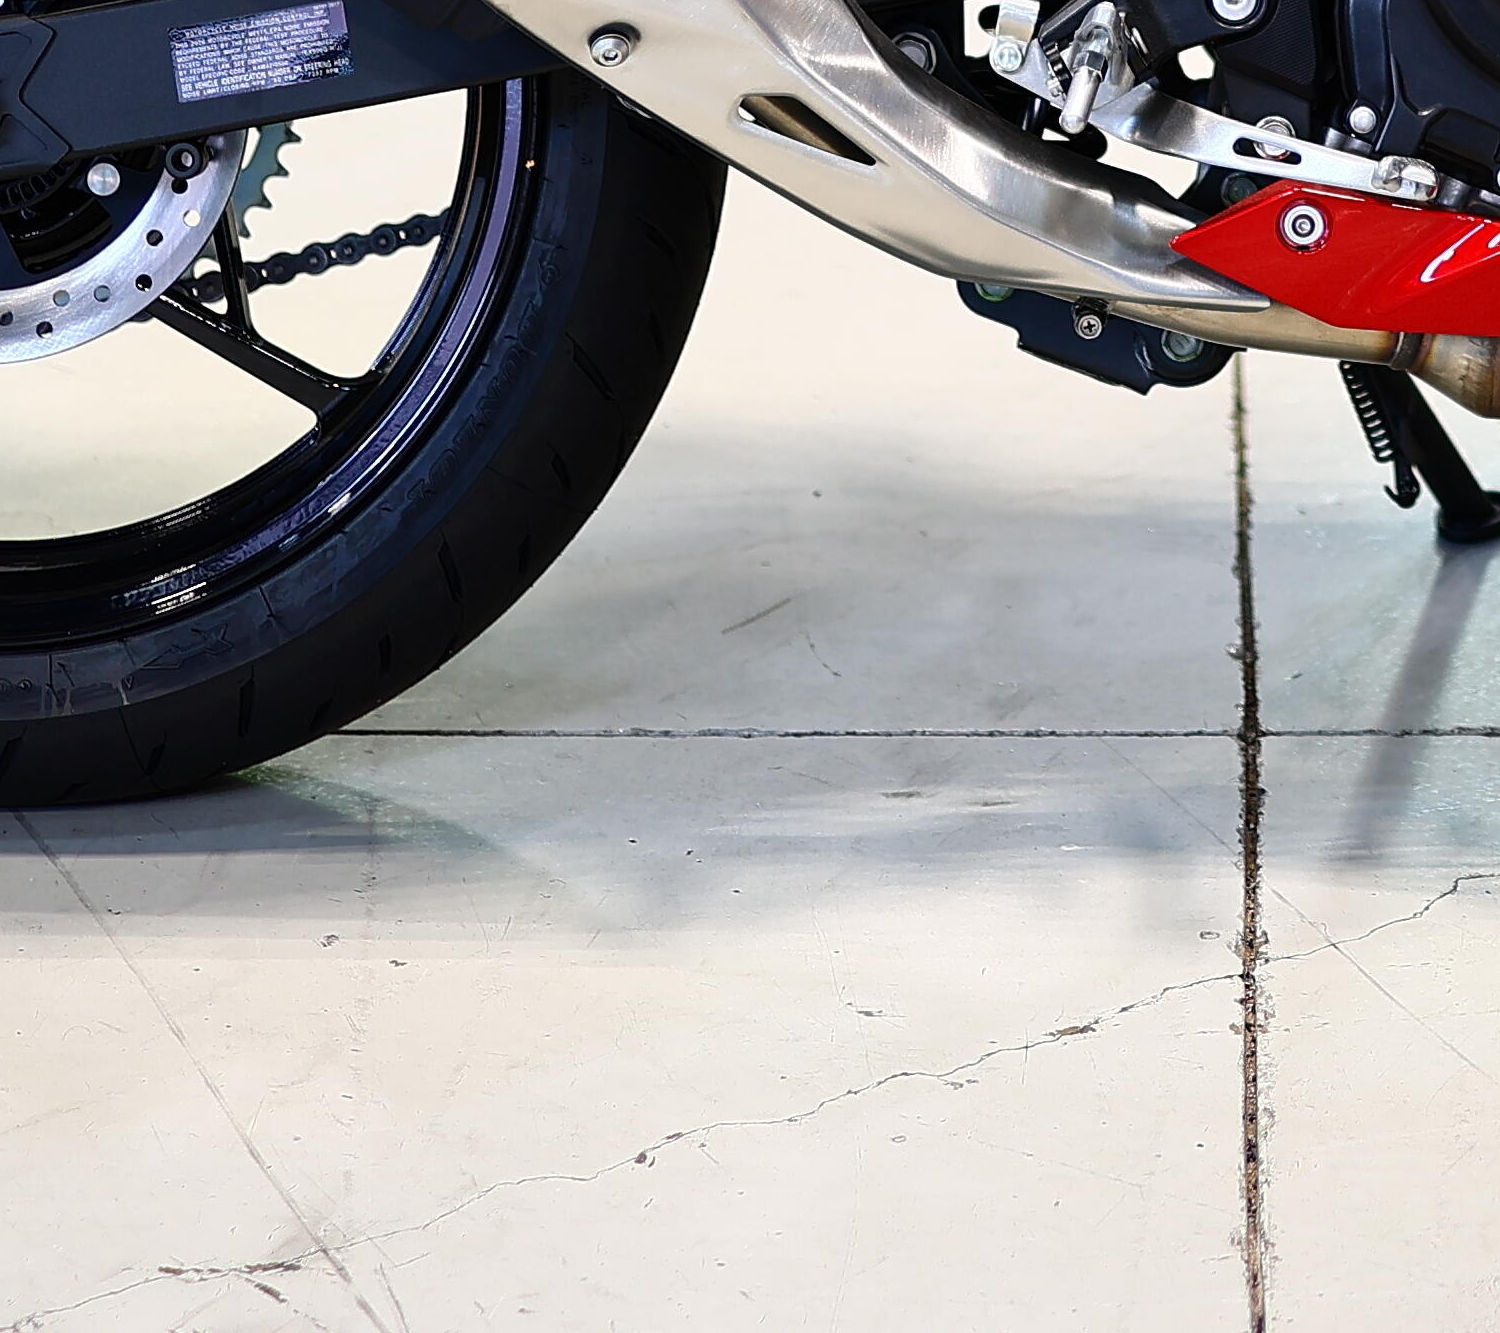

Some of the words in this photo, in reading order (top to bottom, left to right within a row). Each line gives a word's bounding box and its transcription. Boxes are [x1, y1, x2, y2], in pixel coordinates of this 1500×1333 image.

[272, 31, 288, 40] TEST
[180, 82, 193, 92] SEE
[193, 77, 218, 90] VEHICLE
[219, 70, 267, 86] IDENTIFICATION
[303, 59, 332, 72] STEERING
[332, 56, 350, 67] HEAD
